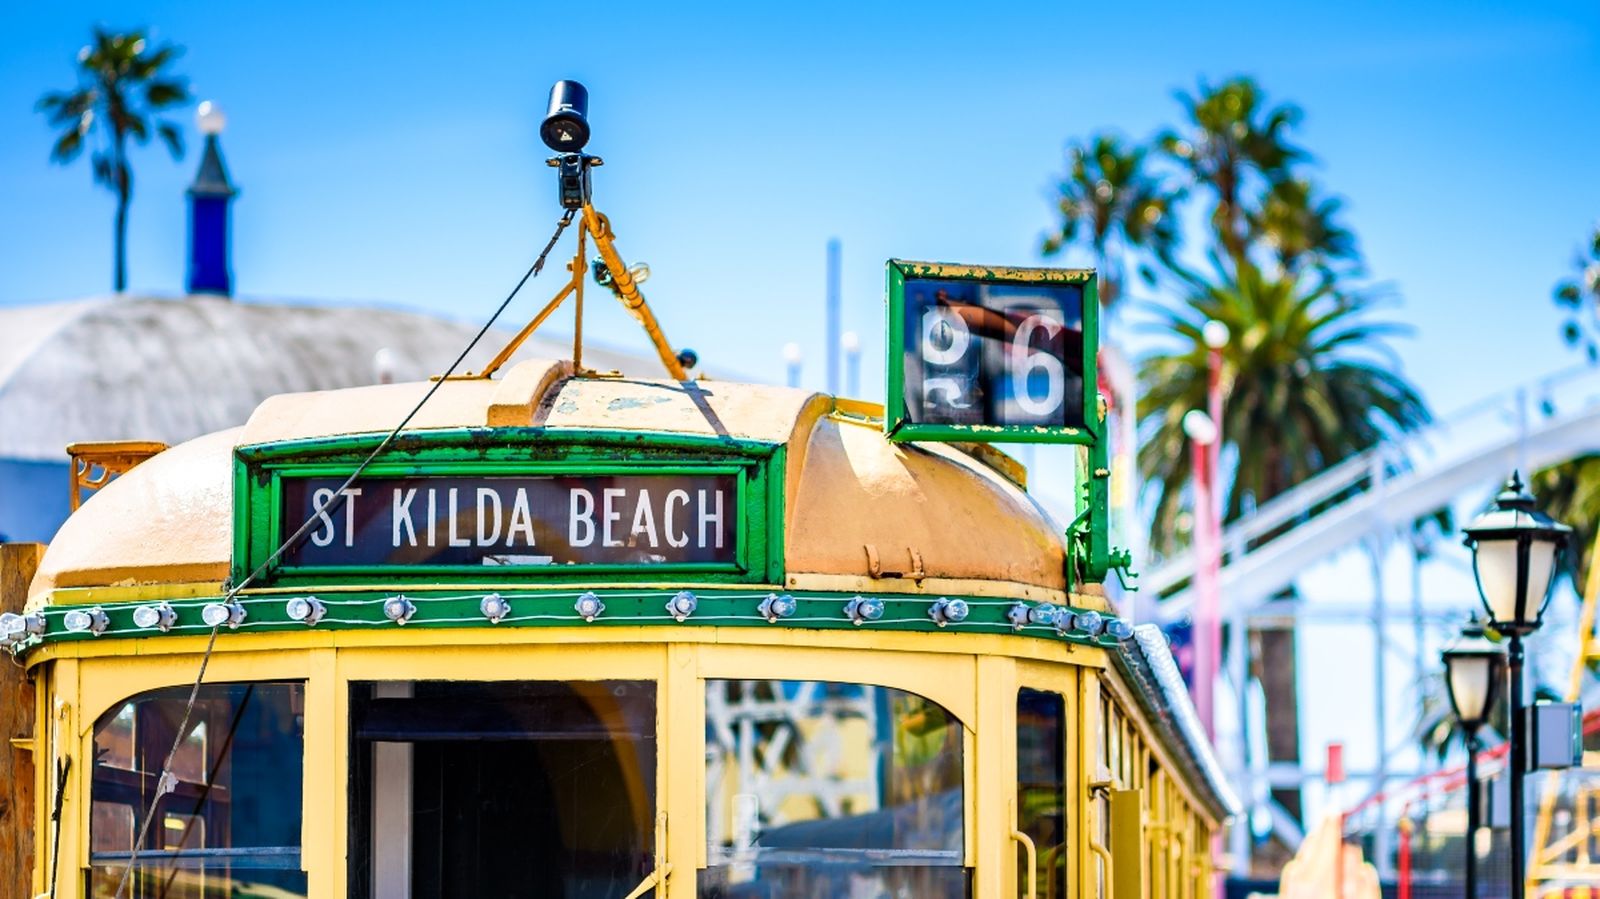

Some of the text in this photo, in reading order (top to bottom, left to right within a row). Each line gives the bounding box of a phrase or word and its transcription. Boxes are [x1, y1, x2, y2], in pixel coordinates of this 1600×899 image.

[310, 487, 725, 549] ST KILDA BEACH
